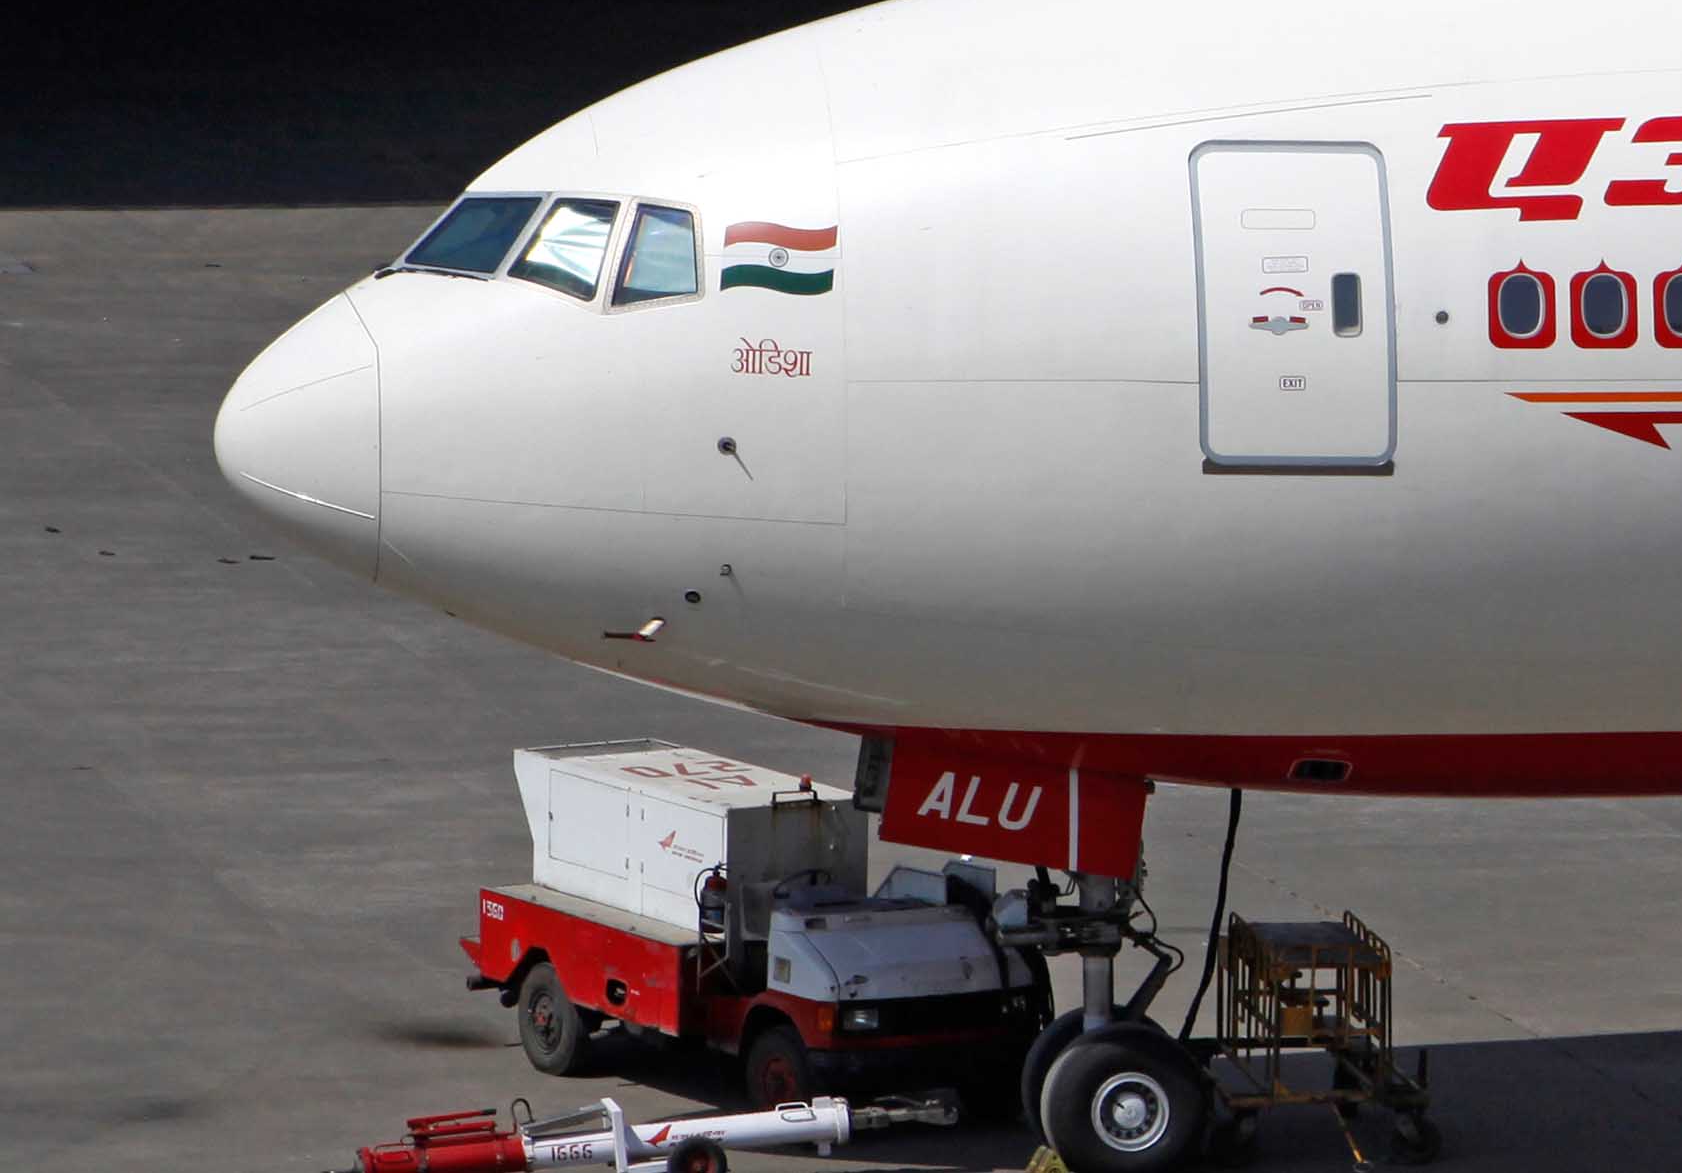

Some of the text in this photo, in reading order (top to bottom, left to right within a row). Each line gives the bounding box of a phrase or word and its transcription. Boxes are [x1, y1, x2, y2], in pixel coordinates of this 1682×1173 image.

[730, 337, 813, 378] ओडिशा
[1283, 378, 1302, 388] EXIT
[917, 772, 1043, 831] ALU
